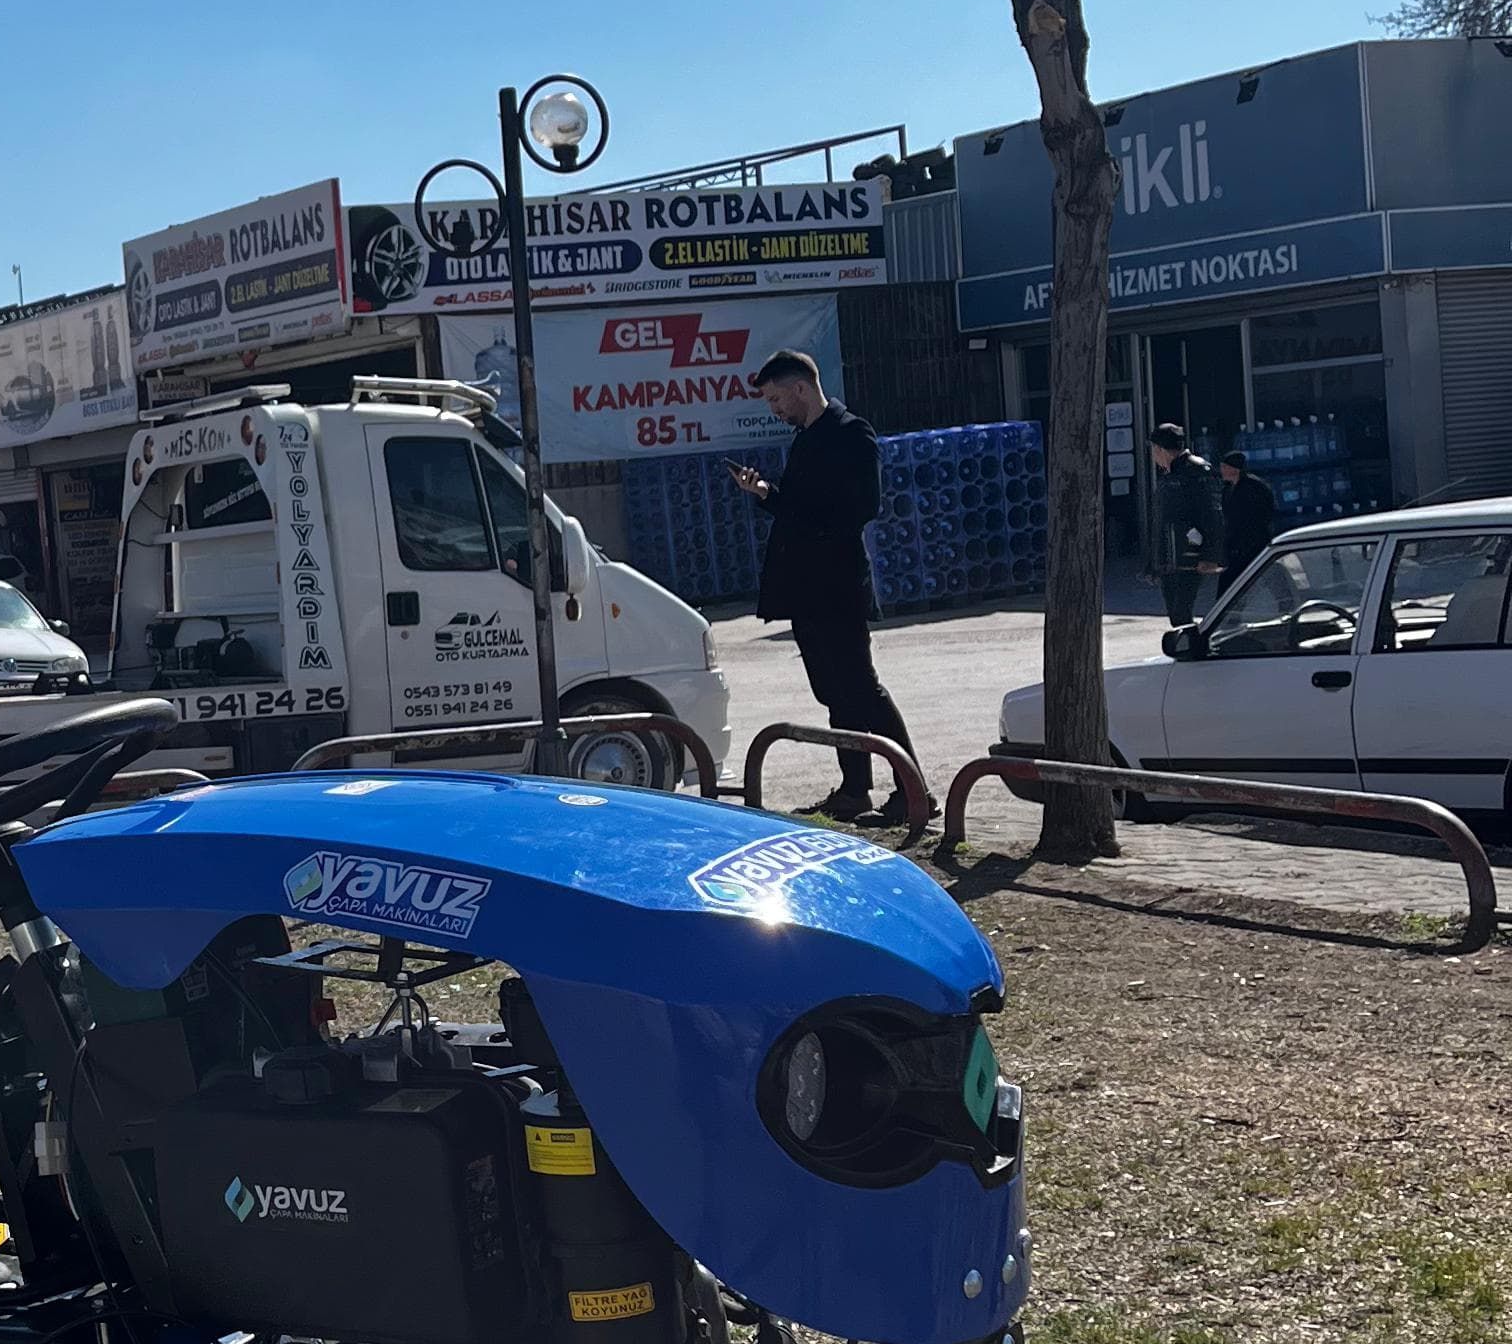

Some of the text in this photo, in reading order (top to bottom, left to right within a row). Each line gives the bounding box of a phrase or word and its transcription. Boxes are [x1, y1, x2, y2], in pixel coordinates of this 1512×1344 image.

[1120, 120, 1210, 215] ikli
[428, 187, 867, 242] KRHİSAR ROTBALANS
[229, 202, 325, 264] ROTBALANS
[664, 242, 695, 266] 2.EL
[697, 234, 750, 264] LASTİK
[760, 236, 797, 258] JANT
[799, 230, 870, 258] DÜZELTME
[445, 245, 623, 281] OTO LAİK & JANT
[1191, 244, 1298, 286] NOKTASI
[605, 277, 683, 294] BRIDGESTONE
[782, 269, 832, 281] MICHELIN
[614, 320, 674, 350] GEL
[689, 334, 728, 364] AL
[572, 374, 764, 413] KAMPANYAS
[636, 416, 711, 447] 85 TL
[435, 646, 530, 663] OTO KURTARMA
[196, 692, 247, 720] 941
[255, 689, 297, 715] 24
[305, 686, 345, 711] 26
[403, 680, 513, 699] 0543 573 81 49
[404, 698, 514, 718] 0551 941 24 26
[306, 856, 485, 918] yavuz
[328, 895, 468, 933] ÇAPA MAKİNALARI
[254, 1184, 348, 1218] yavuz
[581, 1300, 646, 1317] KOYUNUZ
